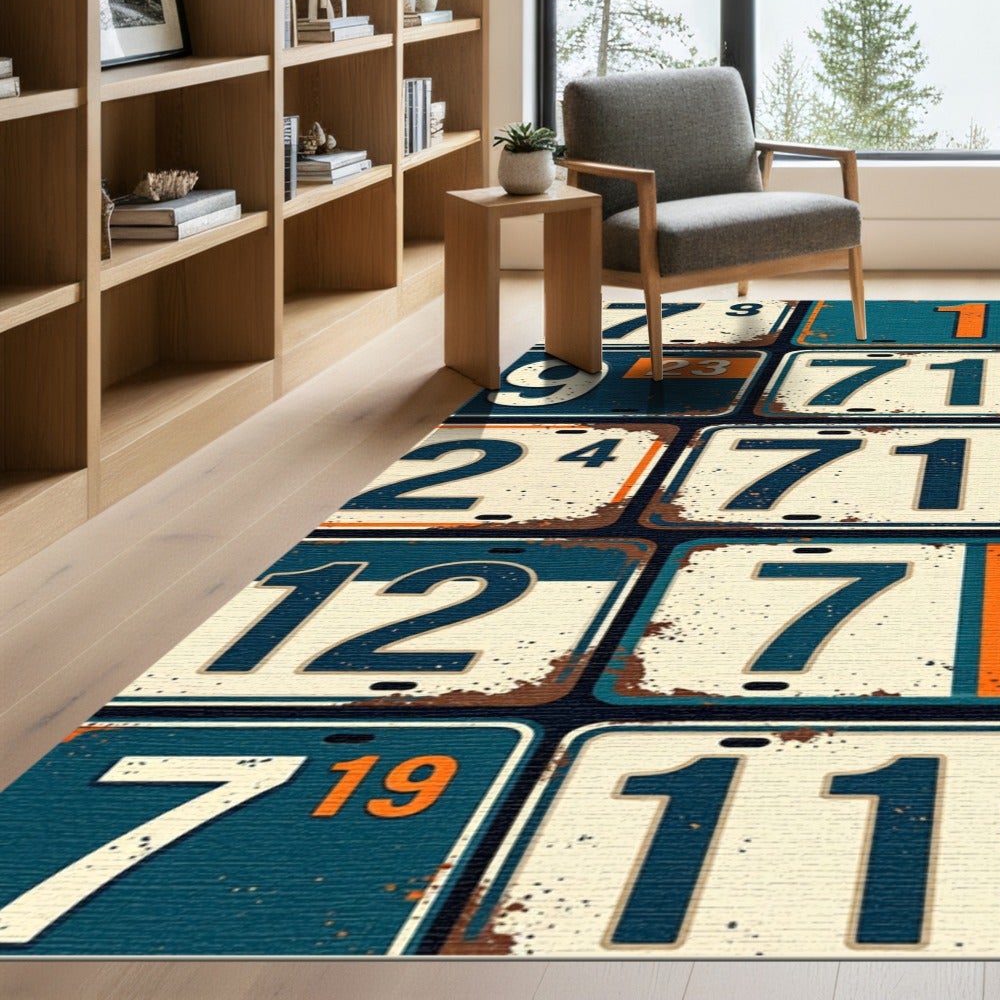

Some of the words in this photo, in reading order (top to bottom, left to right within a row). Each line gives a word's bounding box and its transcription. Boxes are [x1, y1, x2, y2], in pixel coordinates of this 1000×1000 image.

[602, 303, 702, 339] 7
[487, 360, 609, 406] 9
[339, 439, 529, 511] 2
[556, 438, 623, 467] 4
[196, 561, 537, 674] 12
[743, 561, 914, 675] 7
[0, 756, 307, 943] 7
[311, 755, 458, 817] 19
